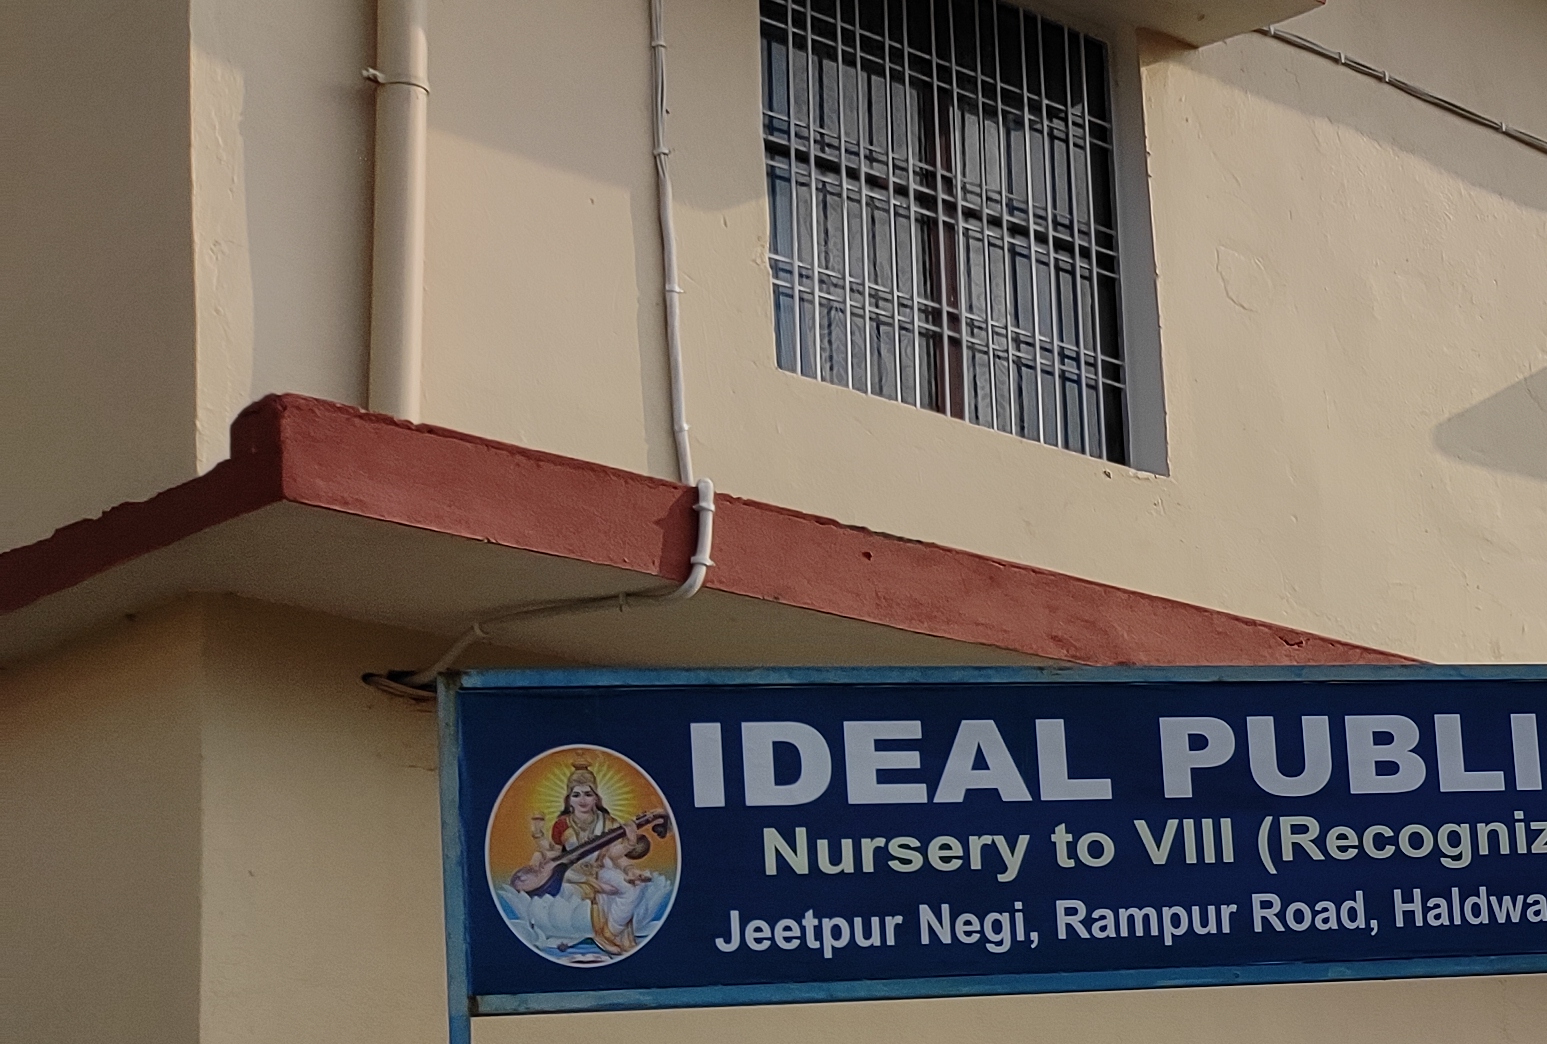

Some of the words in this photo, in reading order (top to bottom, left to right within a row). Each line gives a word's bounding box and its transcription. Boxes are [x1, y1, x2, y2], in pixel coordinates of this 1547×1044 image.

[690, 718, 1113, 808] IDEAL
[763, 827, 1030, 882] Nursery
[1050, 823, 1115, 868] to
[1133, 817, 1234, 865] VIII
[715, 909, 903, 952] Jeetpur
[919, 901, 1039, 953] Negi,
[1055, 899, 1238, 946] Rampur
[1251, 890, 1378, 936] Road,
